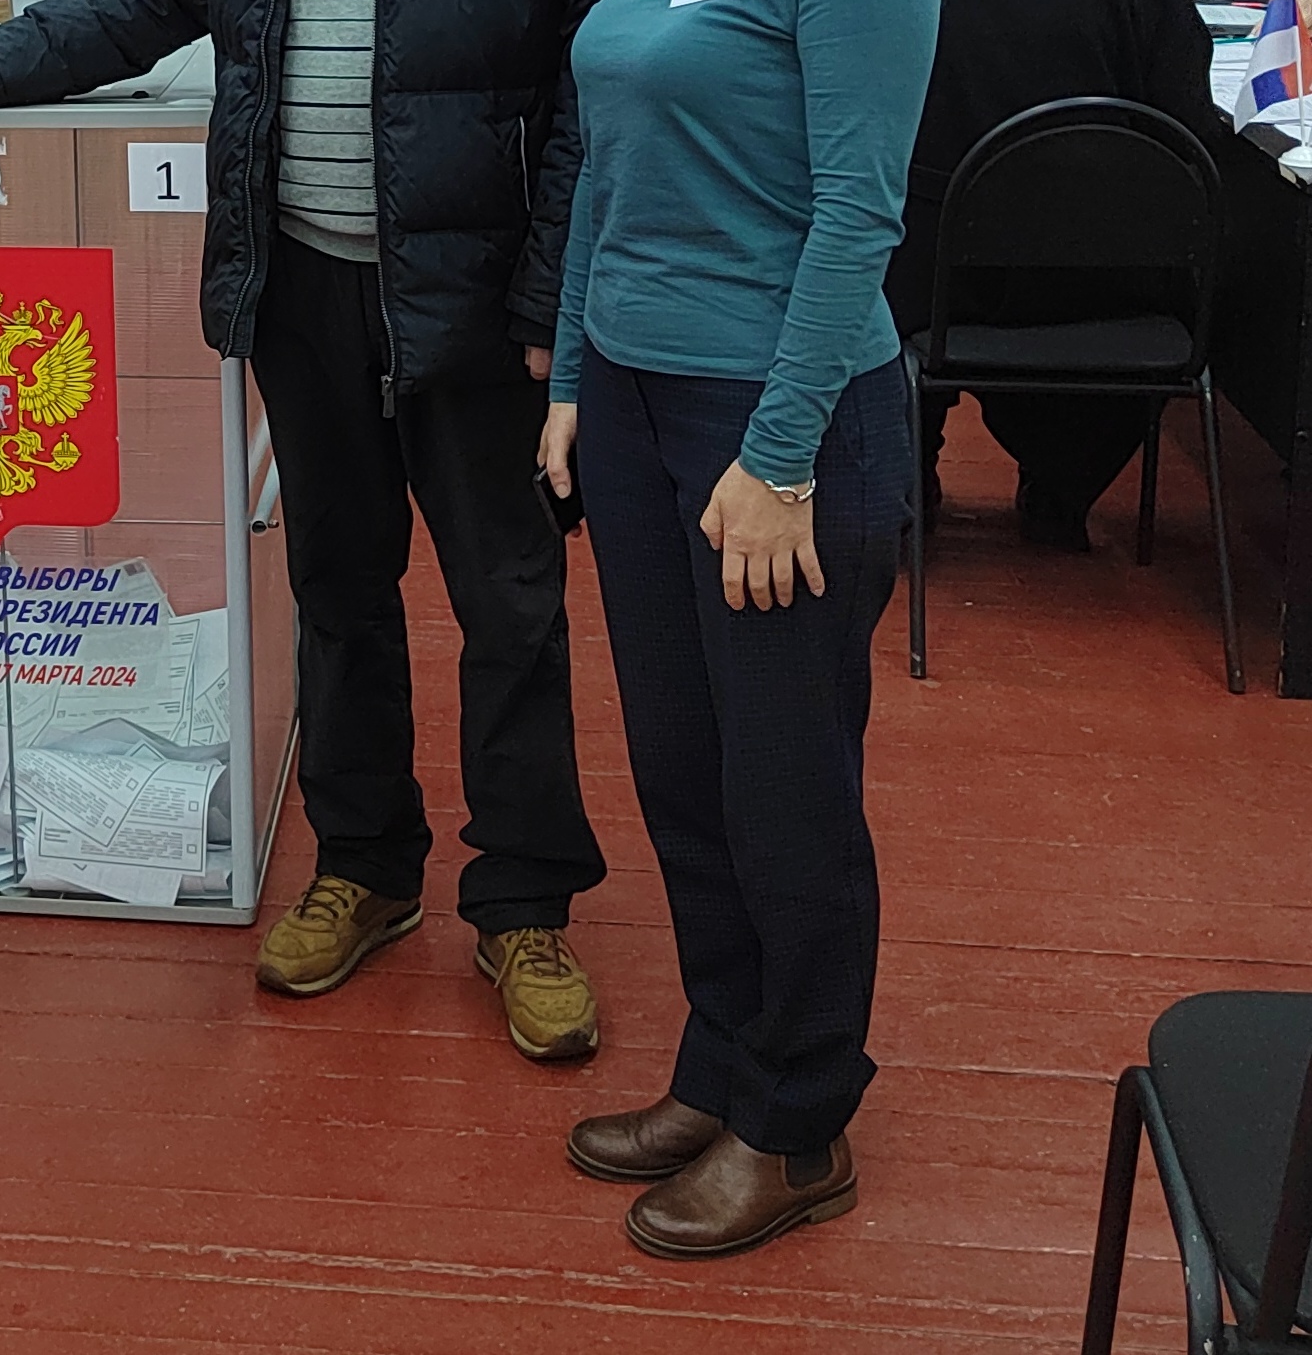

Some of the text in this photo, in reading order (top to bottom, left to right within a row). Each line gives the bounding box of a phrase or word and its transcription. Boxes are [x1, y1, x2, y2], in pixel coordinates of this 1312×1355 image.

[156, 161, 180, 200] 1
[14, 663, 84, 686] МАРТА
[86, 665, 138, 687] 2024
